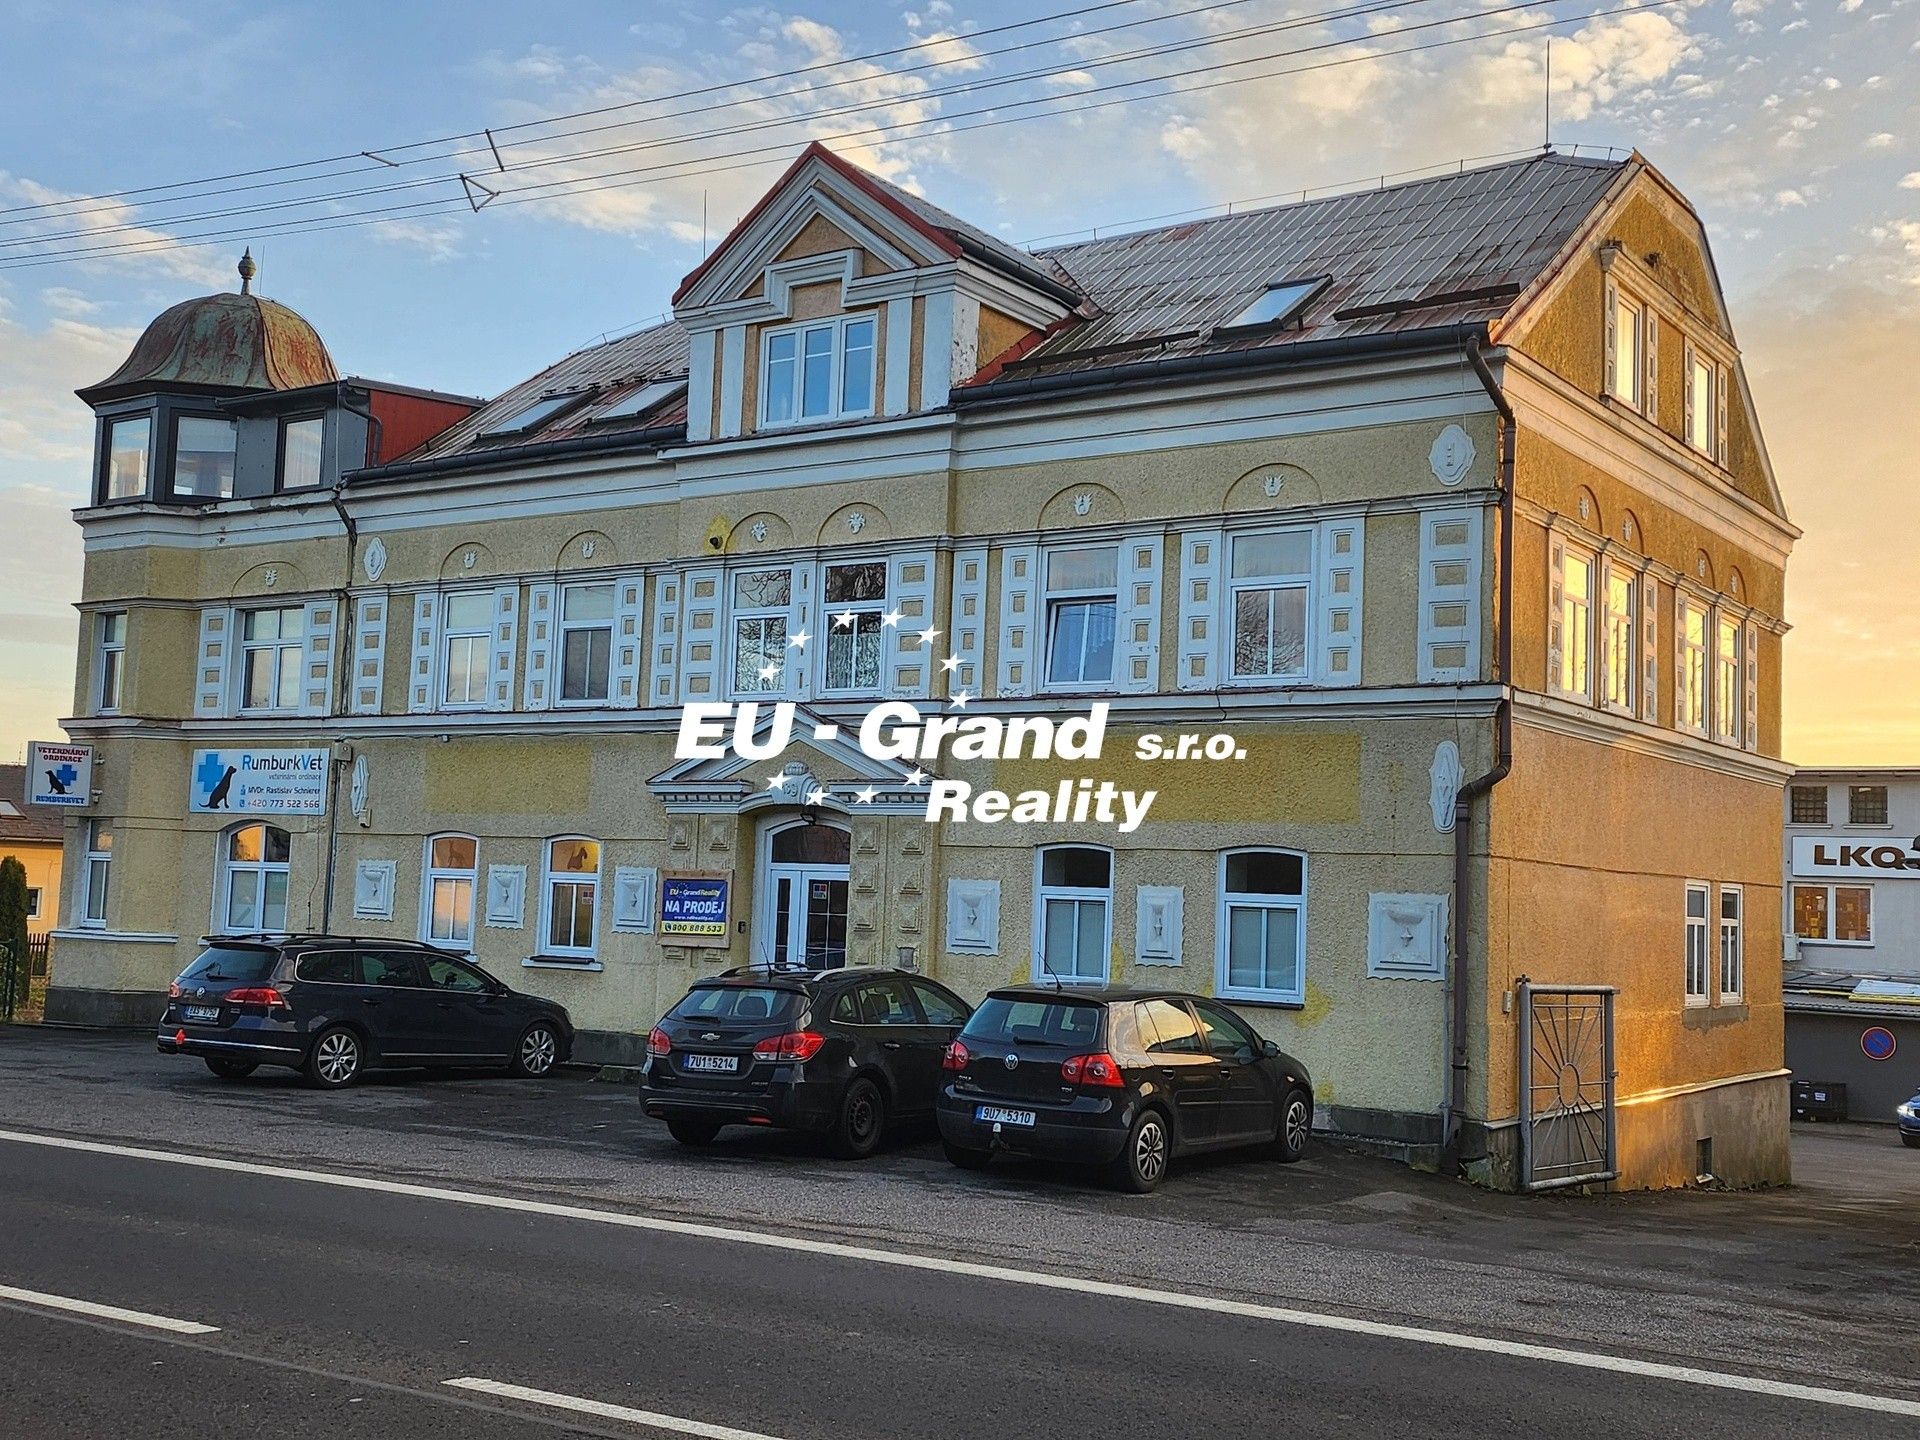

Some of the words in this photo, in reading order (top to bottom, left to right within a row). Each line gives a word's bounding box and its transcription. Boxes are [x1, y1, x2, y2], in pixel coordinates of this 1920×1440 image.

[38, 747, 89, 756] VETERINÁRNÍ
[242, 755, 323, 770] RumburkVet
[266, 786, 292, 794] Rastislav
[36, 795, 85, 804] RUMBURKVET
[248, 800, 267, 808] +420
[270, 800, 284, 808] 773
[287, 800, 301, 808] 522
[304, 800, 320, 808] 566
[1814, 845, 1908, 870] LKQ
[665, 900, 680, 912] NA
[683, 901, 725, 914] PRODEJ
[691, 1056, 706, 1068] 7U1
[713, 1056, 734, 1069] 5214
[983, 1107, 1000, 1120] 9U7
[1006, 1111, 1031, 1124] 5310
